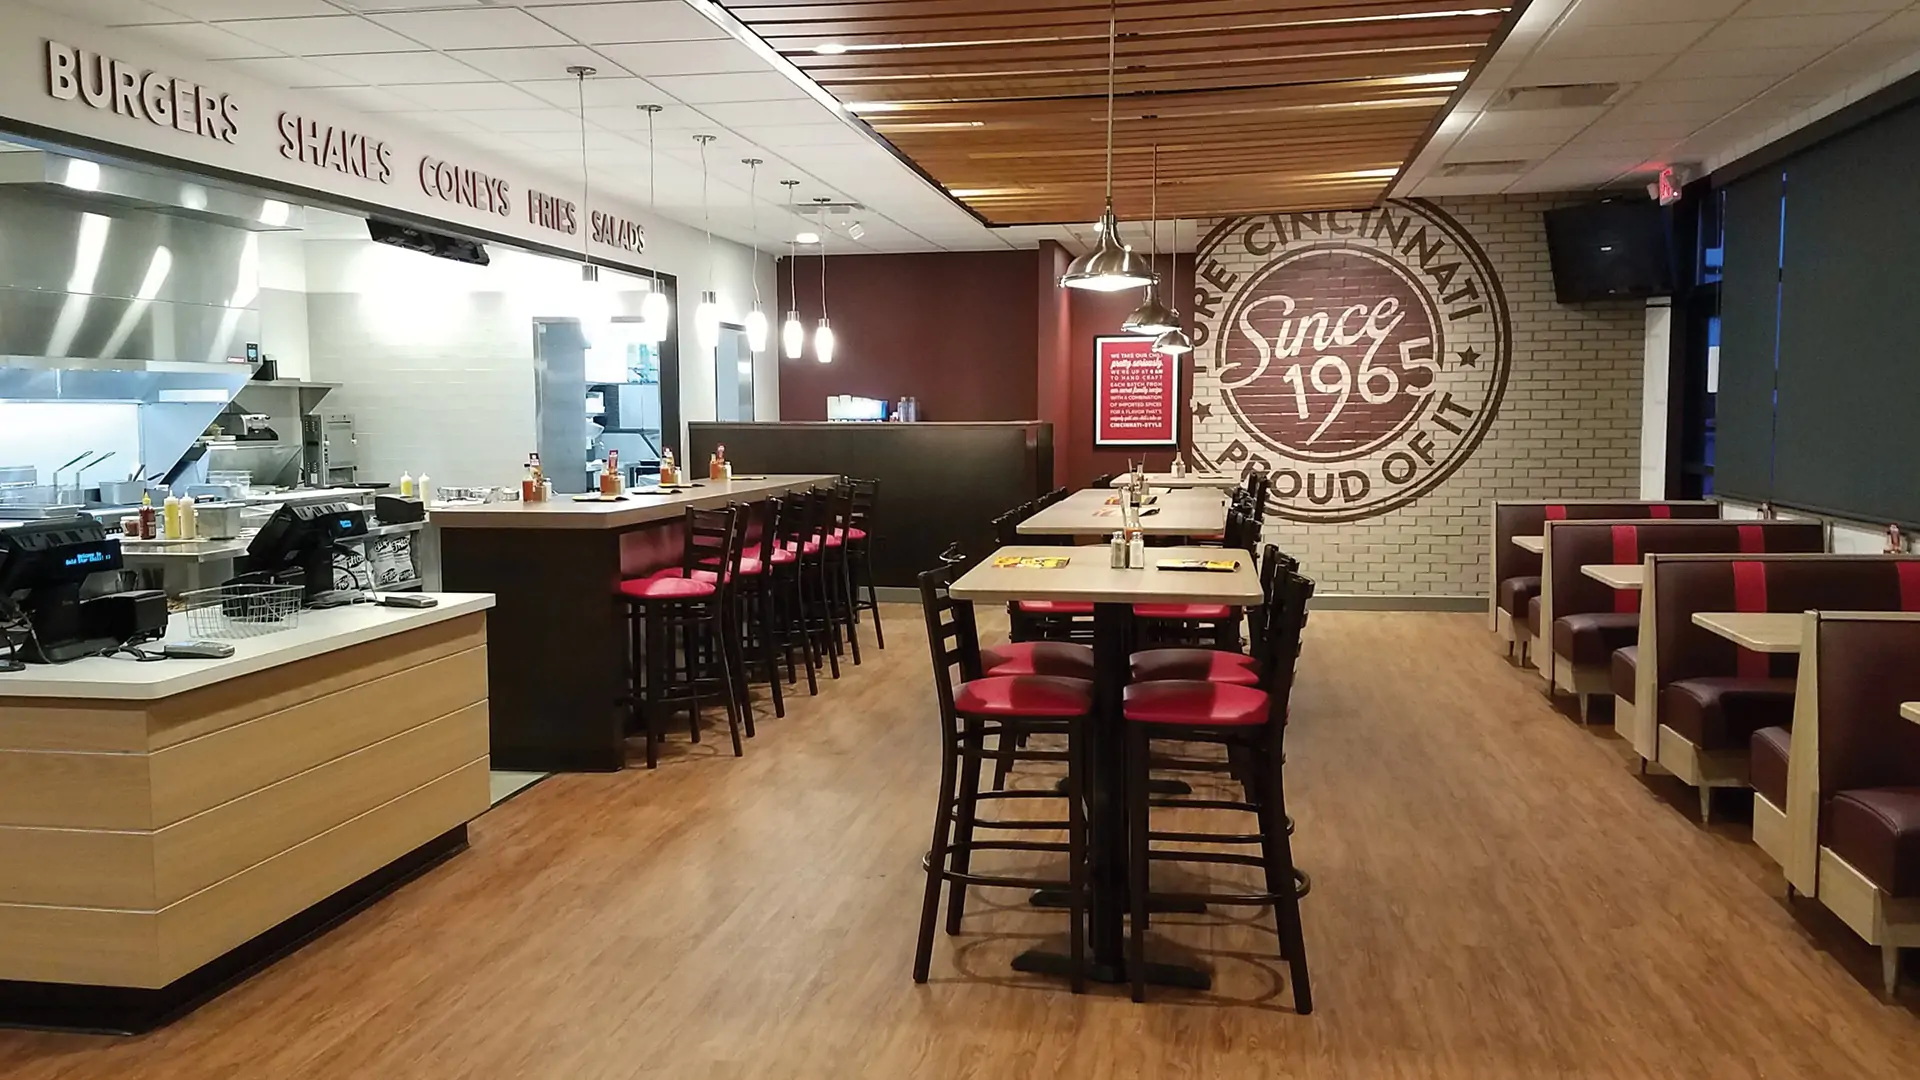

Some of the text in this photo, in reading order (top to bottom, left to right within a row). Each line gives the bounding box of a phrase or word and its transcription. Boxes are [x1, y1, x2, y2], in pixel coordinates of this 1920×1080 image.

[47, 40, 646, 255] BURGERS SHAKES CONEYS FRIES SALADS
[1244, 208, 1483, 321] CINCINNATI
[1218, 295, 1406, 390] Since
[1282, 335, 1441, 446] 1965
[1215, 392, 1474, 504] PROUD OF IT
